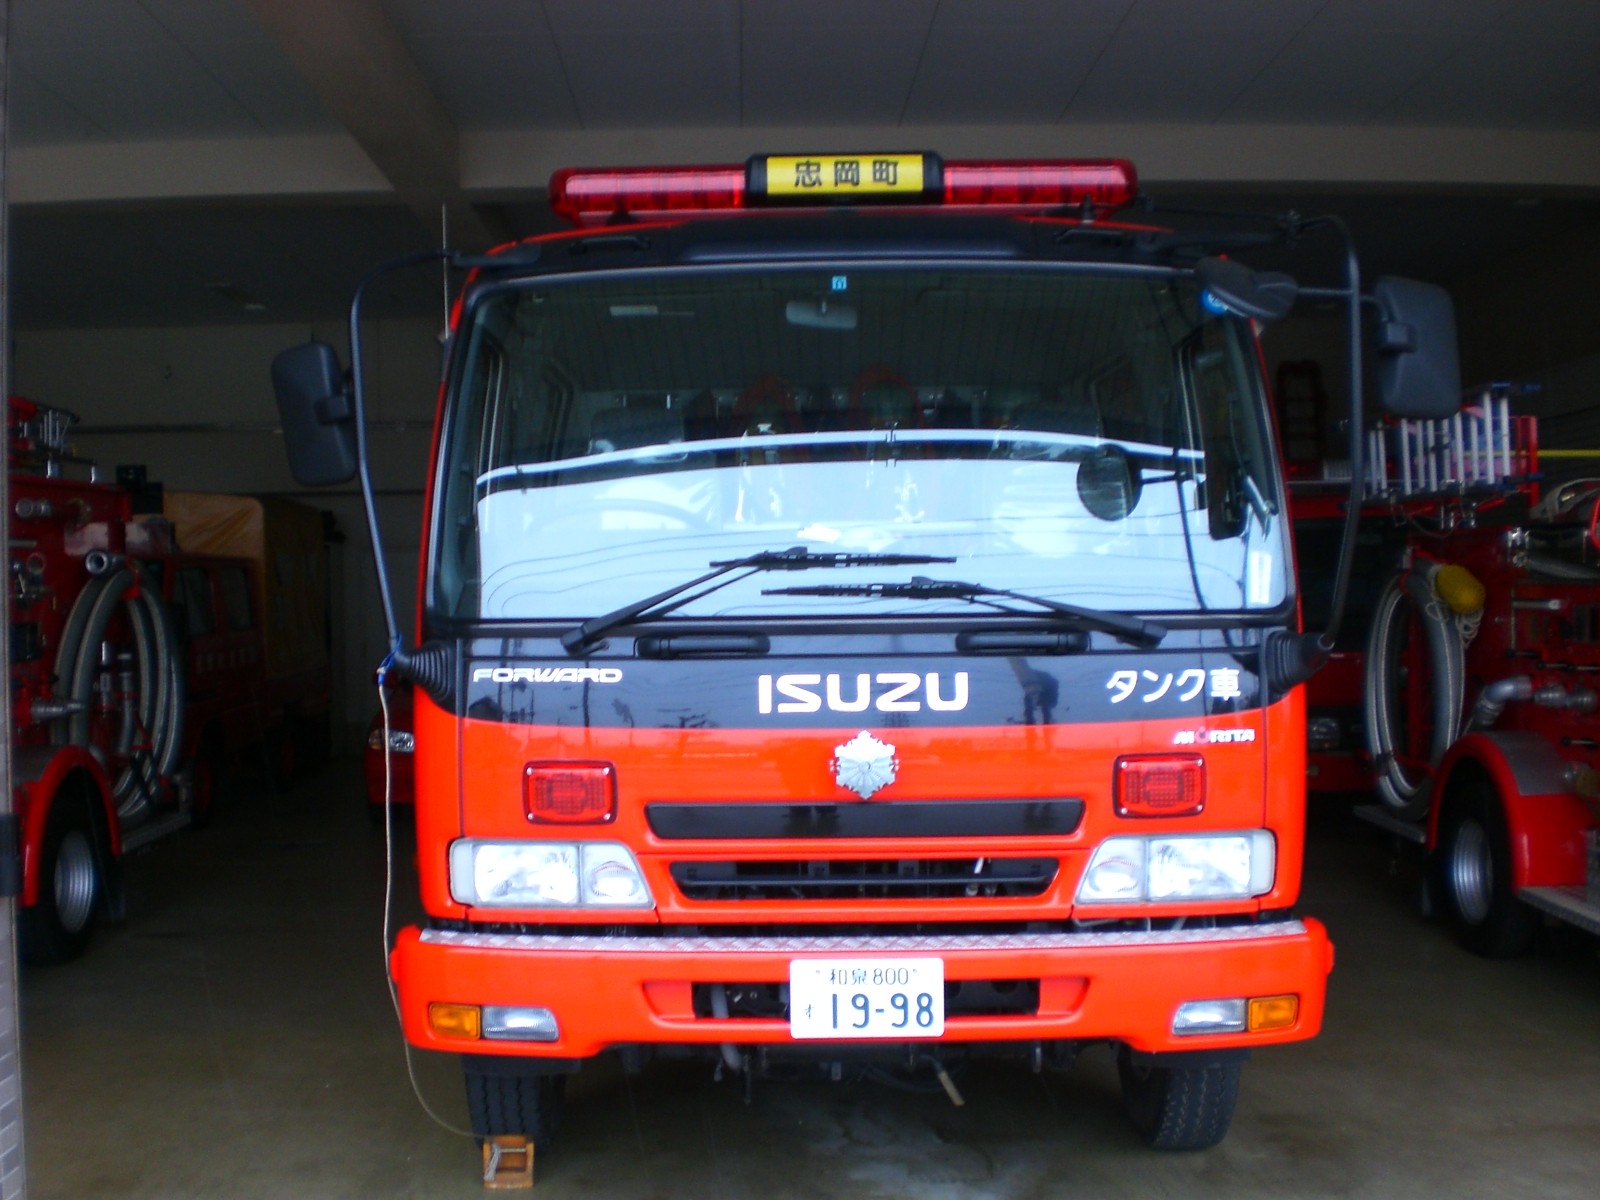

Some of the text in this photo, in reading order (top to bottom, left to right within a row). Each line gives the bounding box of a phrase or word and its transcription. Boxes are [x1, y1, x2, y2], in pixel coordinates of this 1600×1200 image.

[794, 159, 899, 188] 忠岡町
[473, 667, 623, 683] FORWARD
[758, 671, 969, 714] ISUZU
[1106, 667, 1241, 704] タンク車
[831, 992, 934, 1030] 19-98
